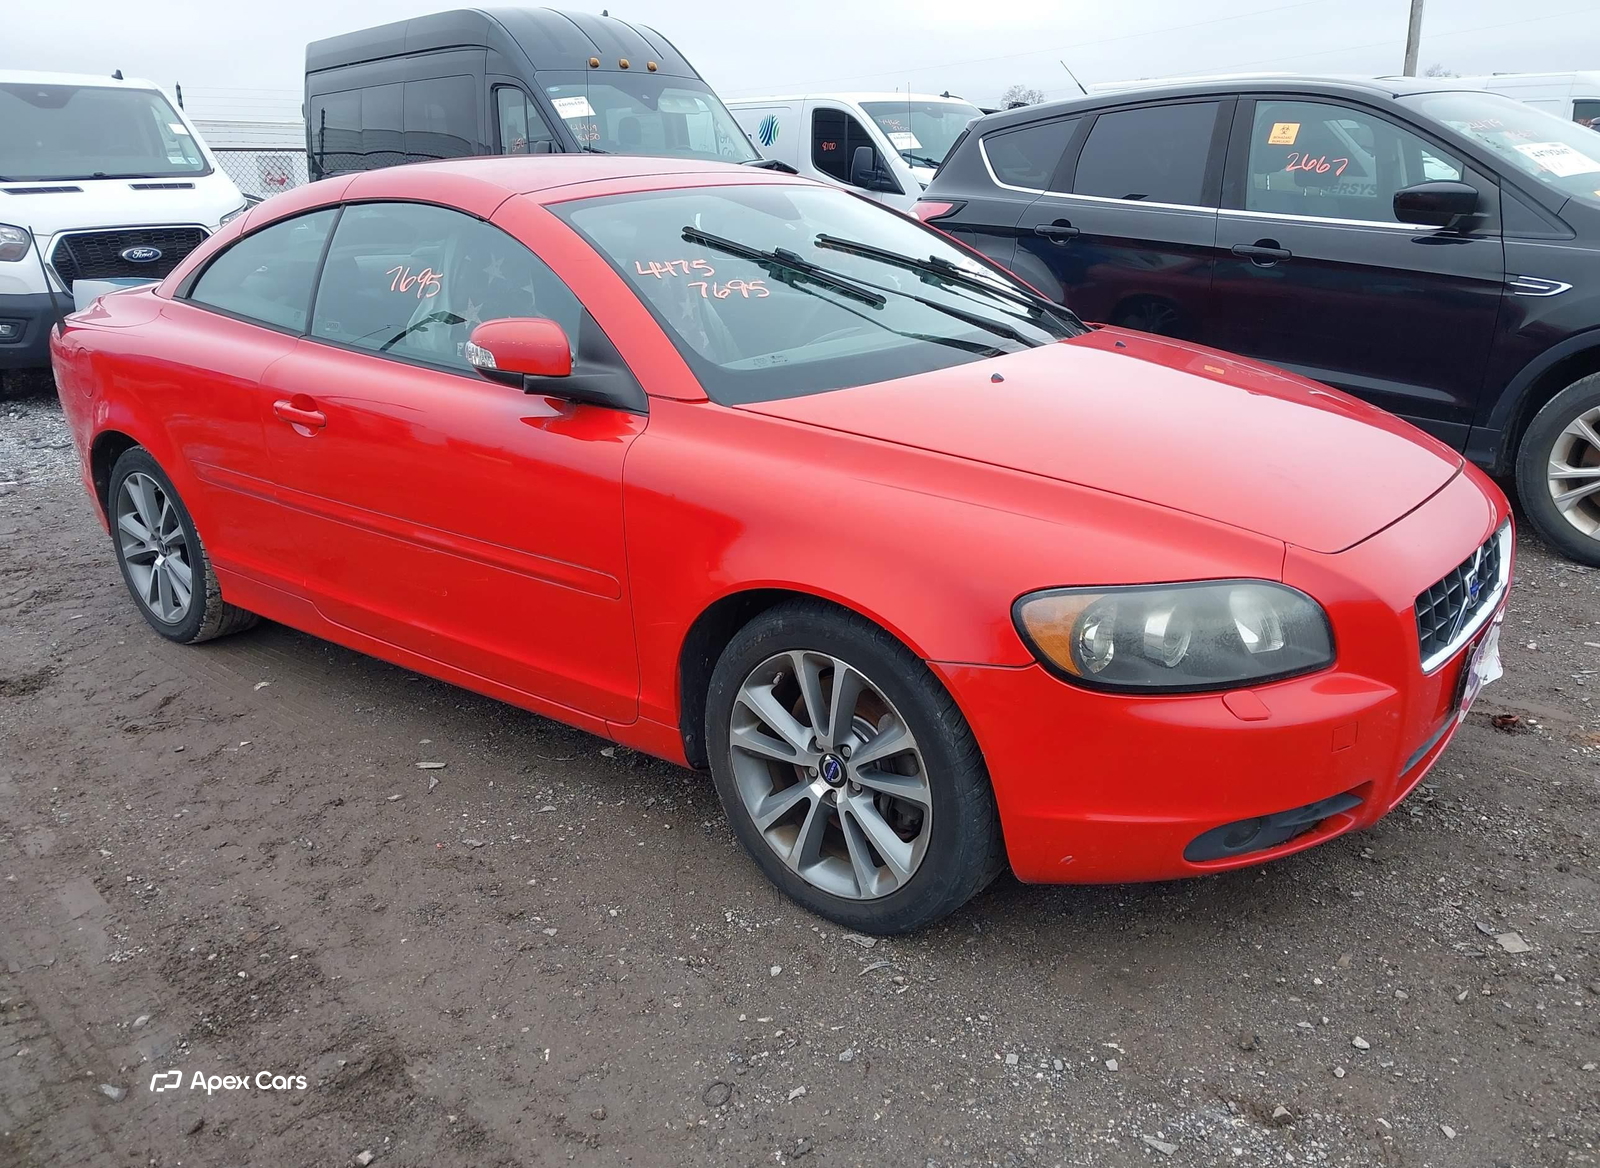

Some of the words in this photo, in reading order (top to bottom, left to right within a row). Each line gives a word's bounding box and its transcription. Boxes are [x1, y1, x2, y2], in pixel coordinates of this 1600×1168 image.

[1285, 152, 1349, 176] 2667
[132, 249, 154, 259] Ford
[634, 259, 715, 279] 4475
[386, 265, 444, 299] 7695
[686, 279, 770, 299] 7695
